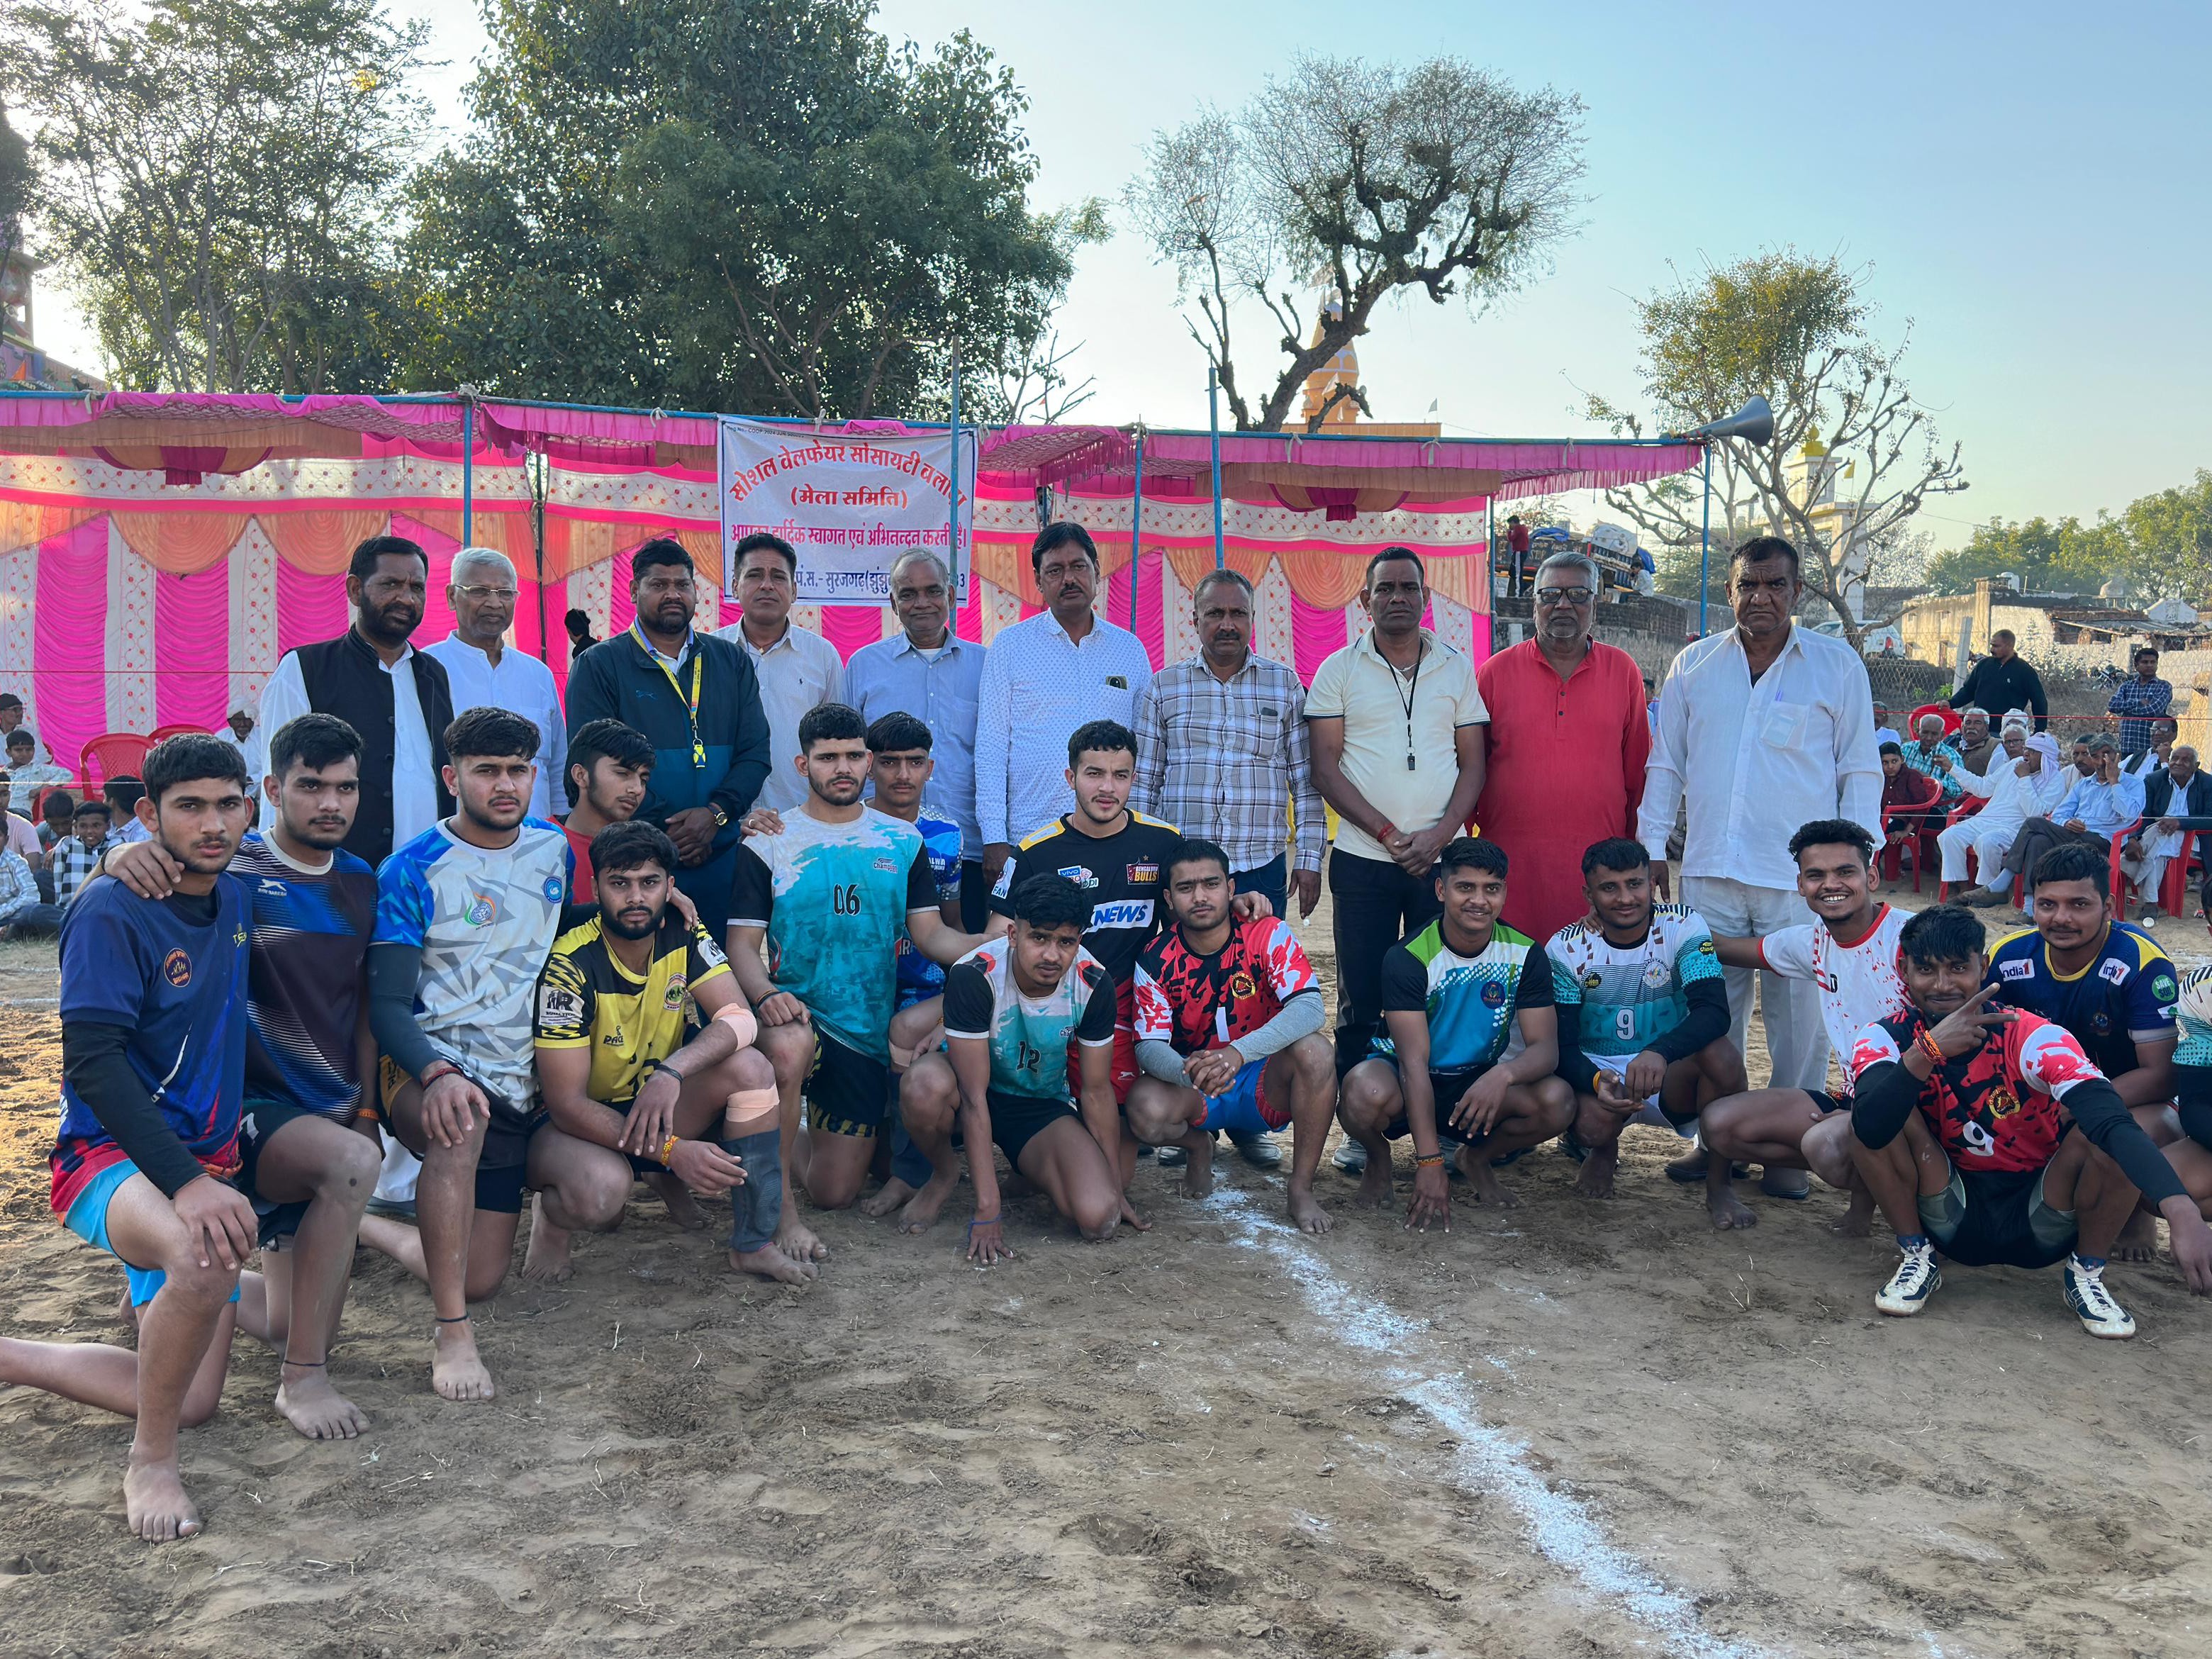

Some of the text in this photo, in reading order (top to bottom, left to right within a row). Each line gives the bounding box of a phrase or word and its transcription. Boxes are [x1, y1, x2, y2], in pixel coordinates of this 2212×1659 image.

[730, 457, 778, 501] सोशल
[778, 439, 846, 470] वेलफेयर
[849, 442, 921, 476] सोसायटी
[791, 483, 908, 510] (मेला समिति)
[808, 527, 847, 545] स्वागत
[849, 522, 866, 549] एवं
[867, 522, 921, 548] अभिनन्दन
[922, 522, 951, 547] करती
[1134, 871, 1158, 882] BULLS
[834, 883, 861, 916] 06
[993, 886, 1007, 898] FAN
[2003, 962, 2029, 978] ndia1
[2155, 978, 2171, 990] SAVE
[1616, 1008, 1635, 1041] 9
[1017, 1040, 1041, 1073] 12
[1962, 1119, 1994, 1156] 9
